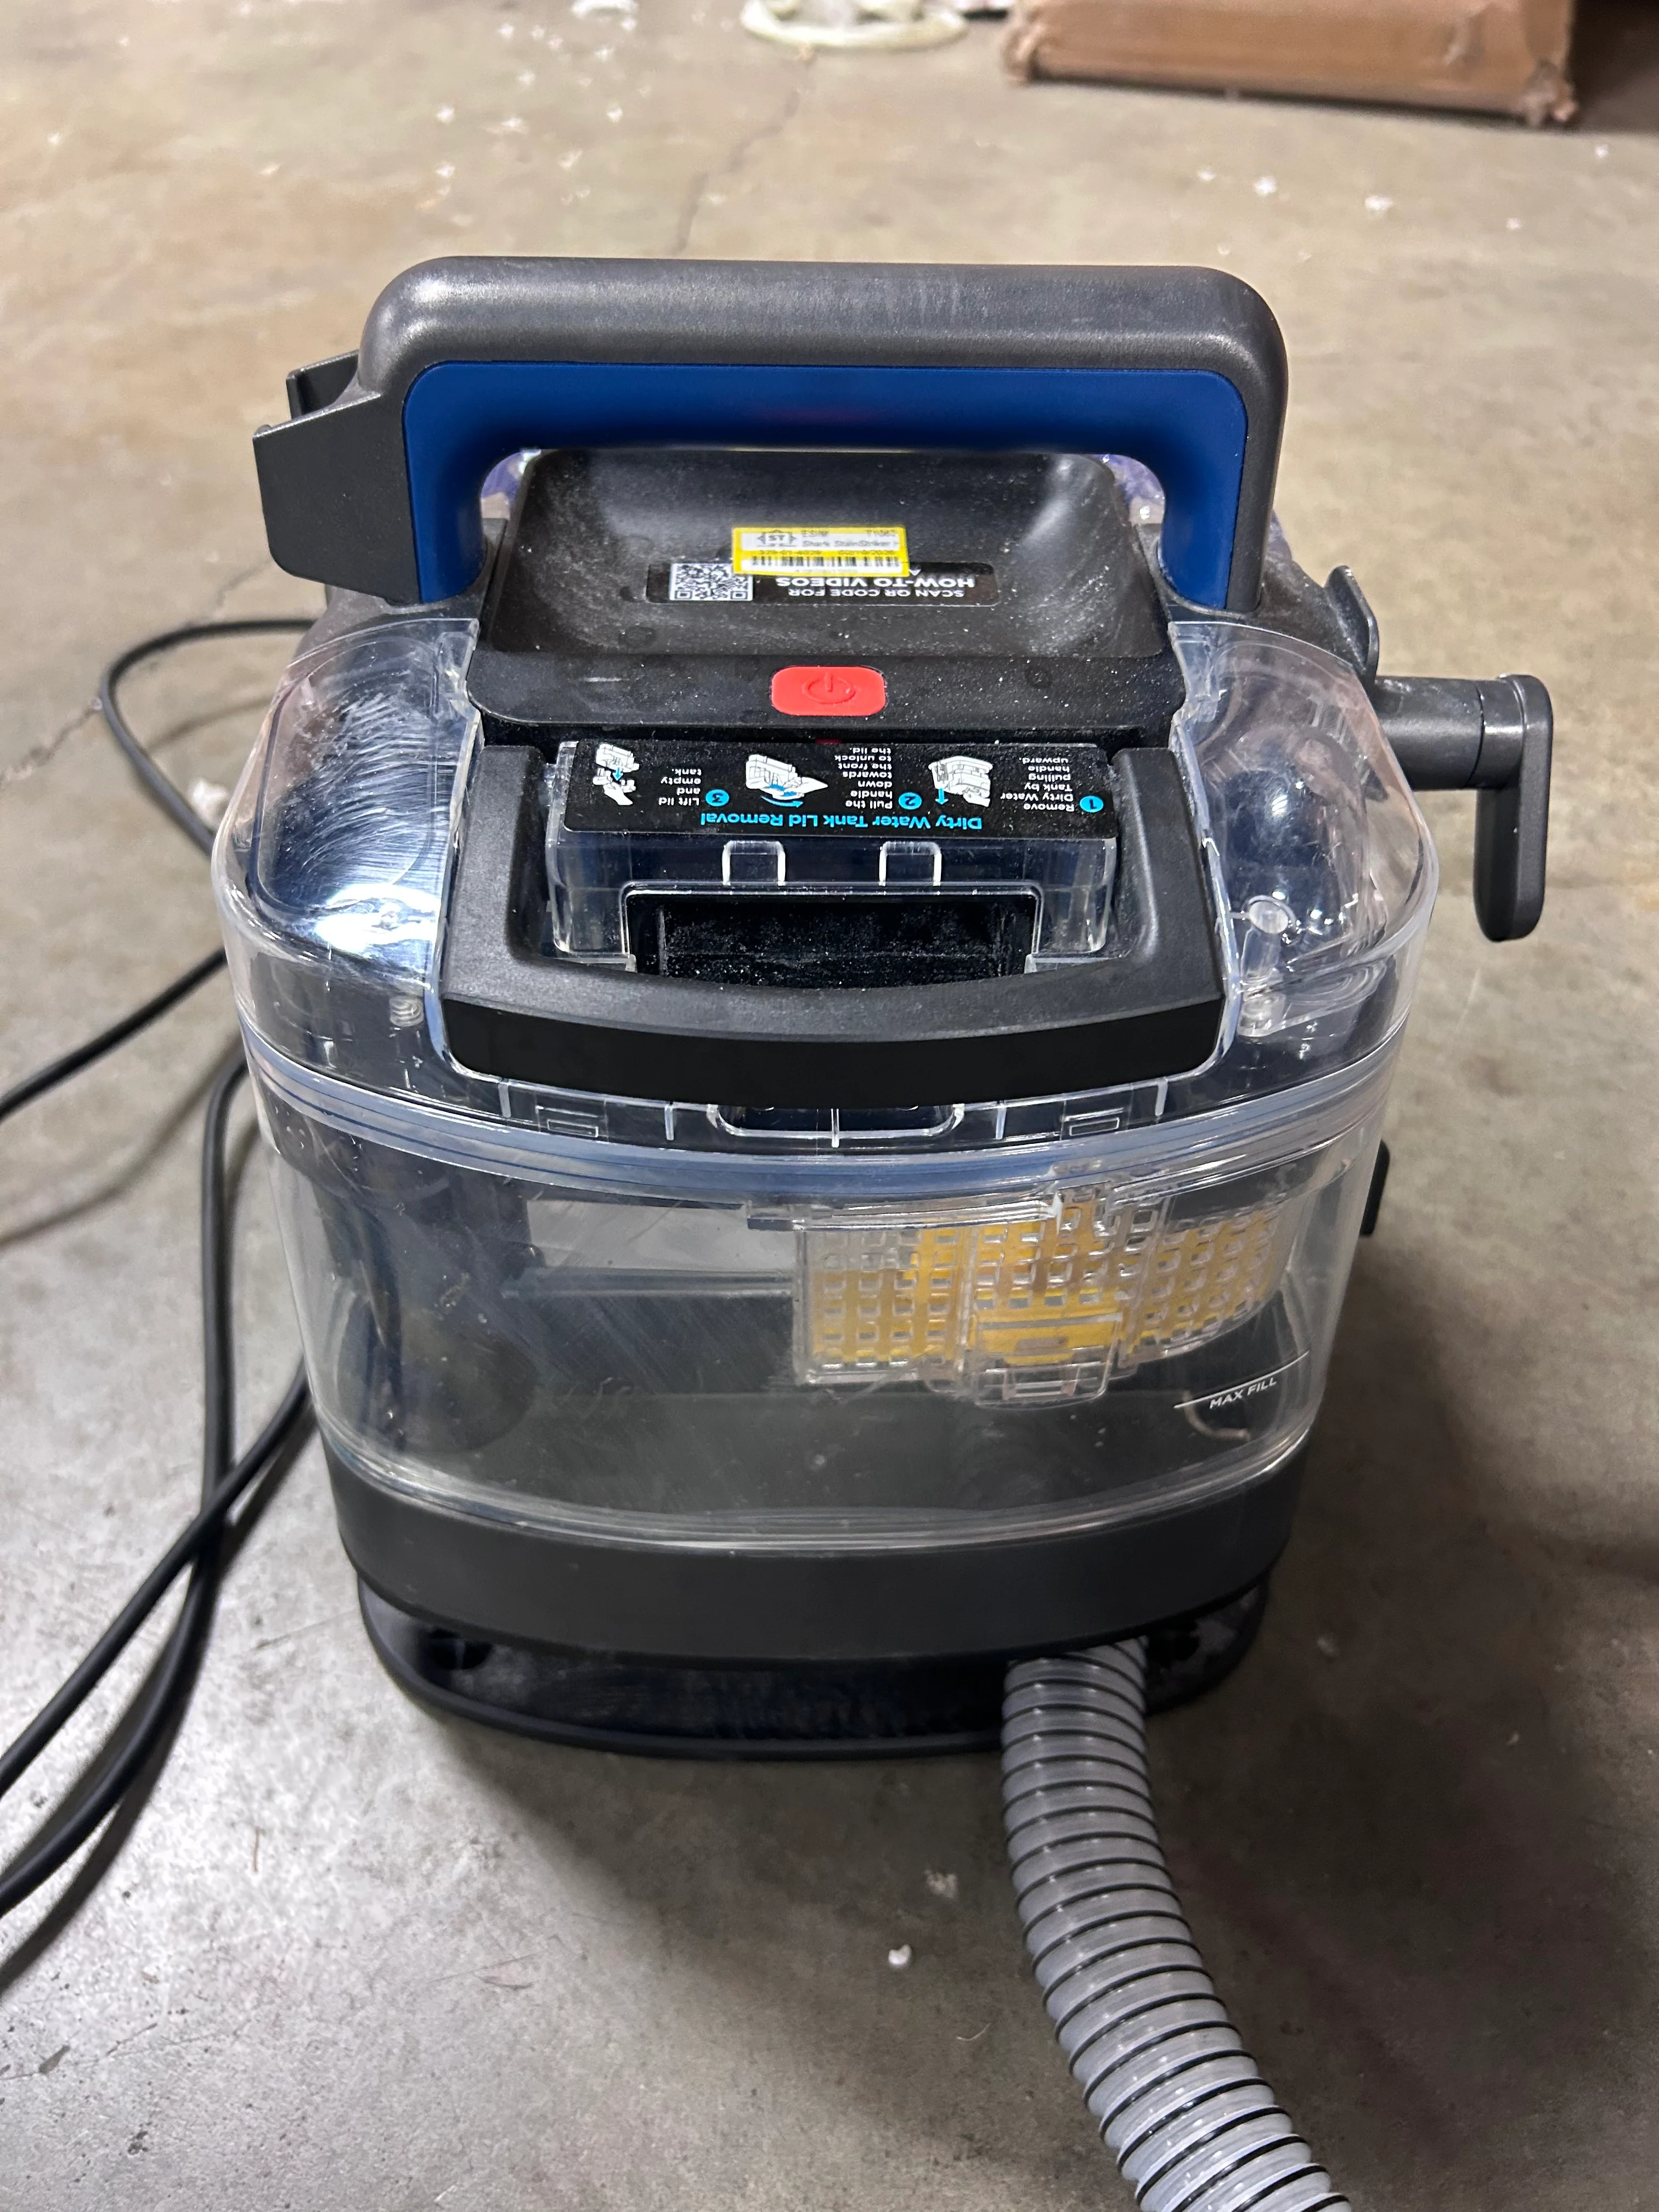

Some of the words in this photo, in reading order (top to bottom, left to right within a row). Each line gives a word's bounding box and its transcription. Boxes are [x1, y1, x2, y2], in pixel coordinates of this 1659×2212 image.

[776, 577, 868, 587] VIDEOS
[873, 577, 975, 588] HOW-TO
[788, 588, 825, 596] FOR
[830, 588, 881, 597] CODE
[884, 589, 911, 597] QR
[915, 589, 965, 597] SCAN
[661, 777, 701, 785] empty
[1028, 773, 1070, 781] pulling
[857, 781, 892, 789] down
[1024, 782, 1040, 792] by
[1043, 783, 1073, 792] Tank
[676, 787, 701, 795] and
[850, 791, 893, 799] handle
[658, 797, 674, 806] lid
[678, 797, 699, 806] Lift
[1000, 793, 1039, 802] Water
[1042, 793, 1074, 802] Dirty
[845, 800, 866, 809] the
[870, 800, 893, 809] Pull
[1023, 803, 1075, 812] Remove
[700, 813, 783, 827] Removal
[789, 813, 818, 827] Lid
[823, 815, 868, 828] Tank
[872, 815, 931, 829] Water
[935, 815, 982, 830] Dirty
[1209, 1389, 1244, 1409] MAX
[1247, 1377, 1277, 1396] FILL
